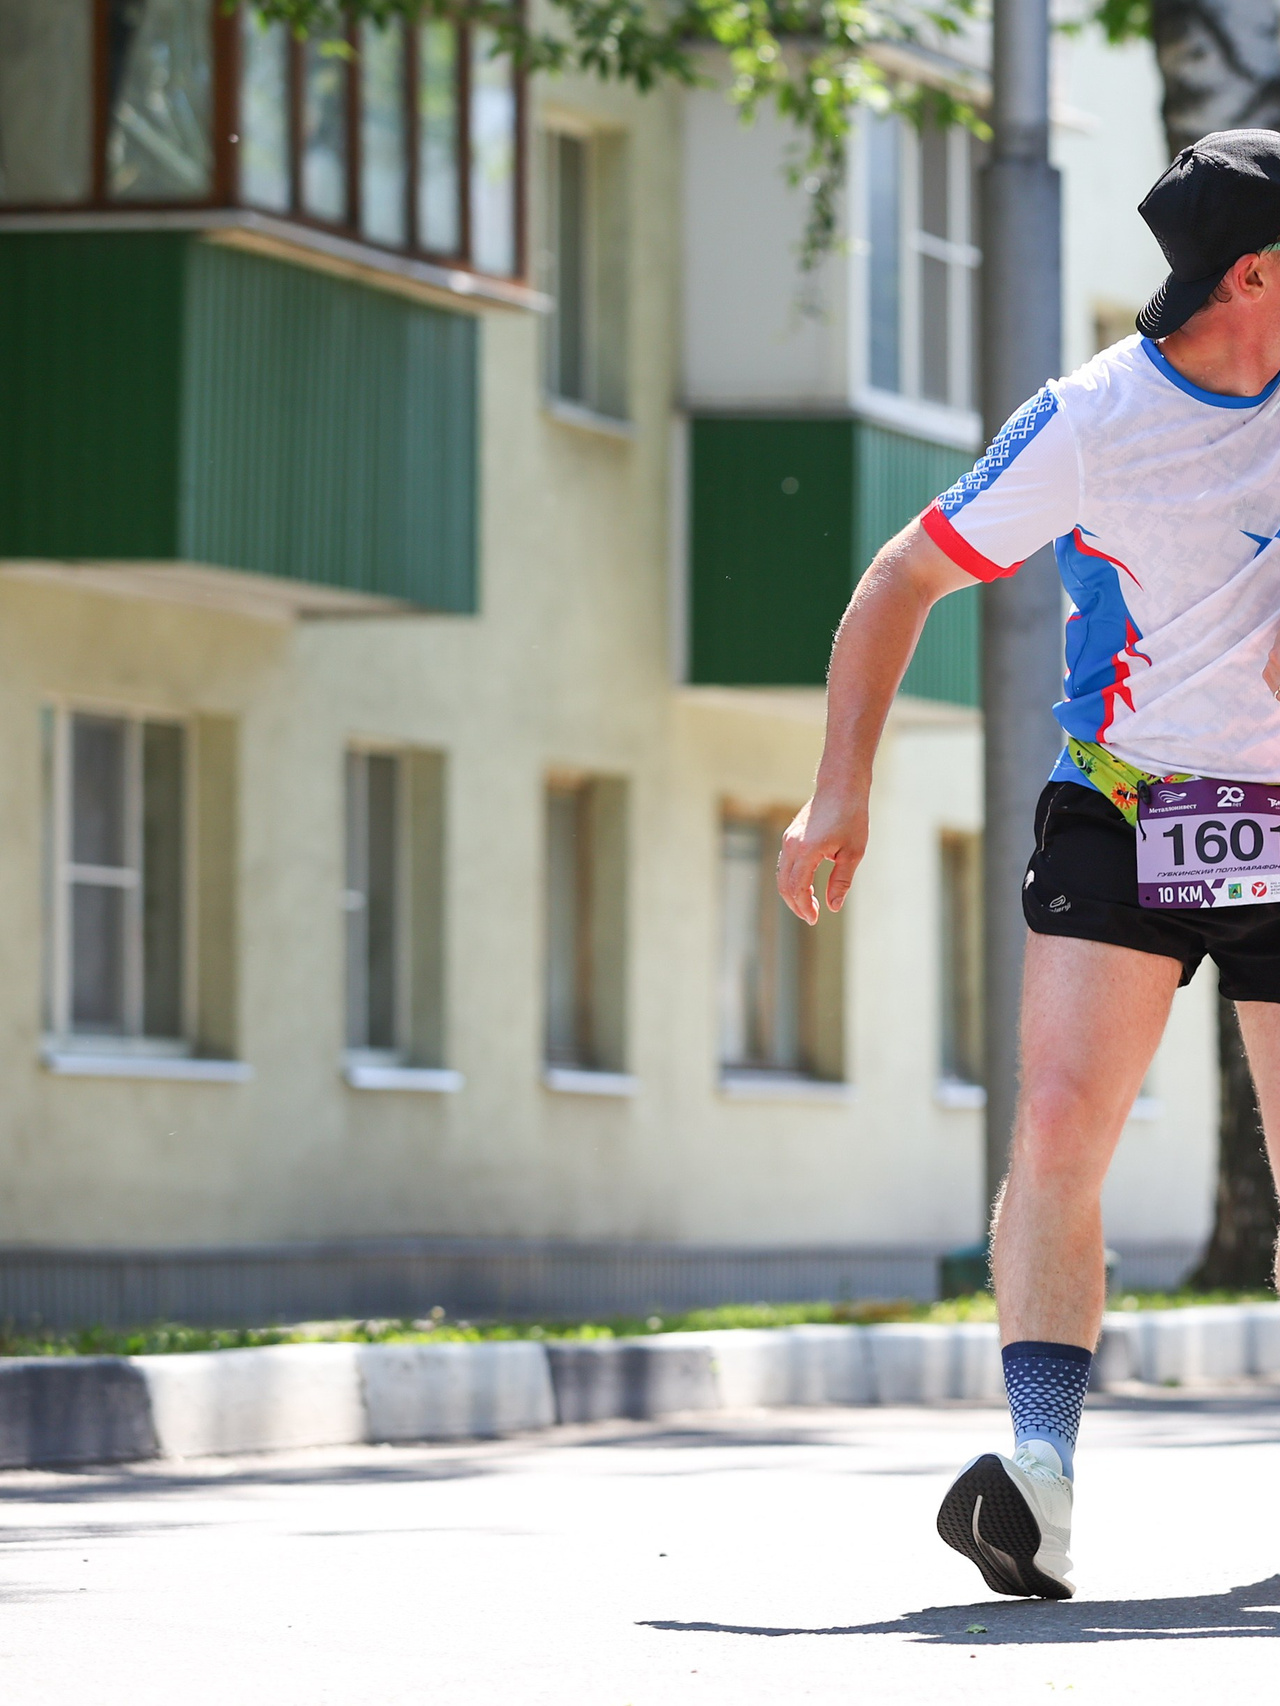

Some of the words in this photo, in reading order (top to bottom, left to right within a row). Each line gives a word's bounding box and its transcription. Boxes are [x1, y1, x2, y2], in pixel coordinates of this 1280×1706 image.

[1217, 786, 1245, 807] 20
[1149, 803, 1198, 814] Металлоинвест
[1157, 868, 1214, 877] ГУБКИНСКИЙ
[1215, 863, 1280, 873] ПОЛУМАРАФОН
[1158, 886, 1174, 903] 10
